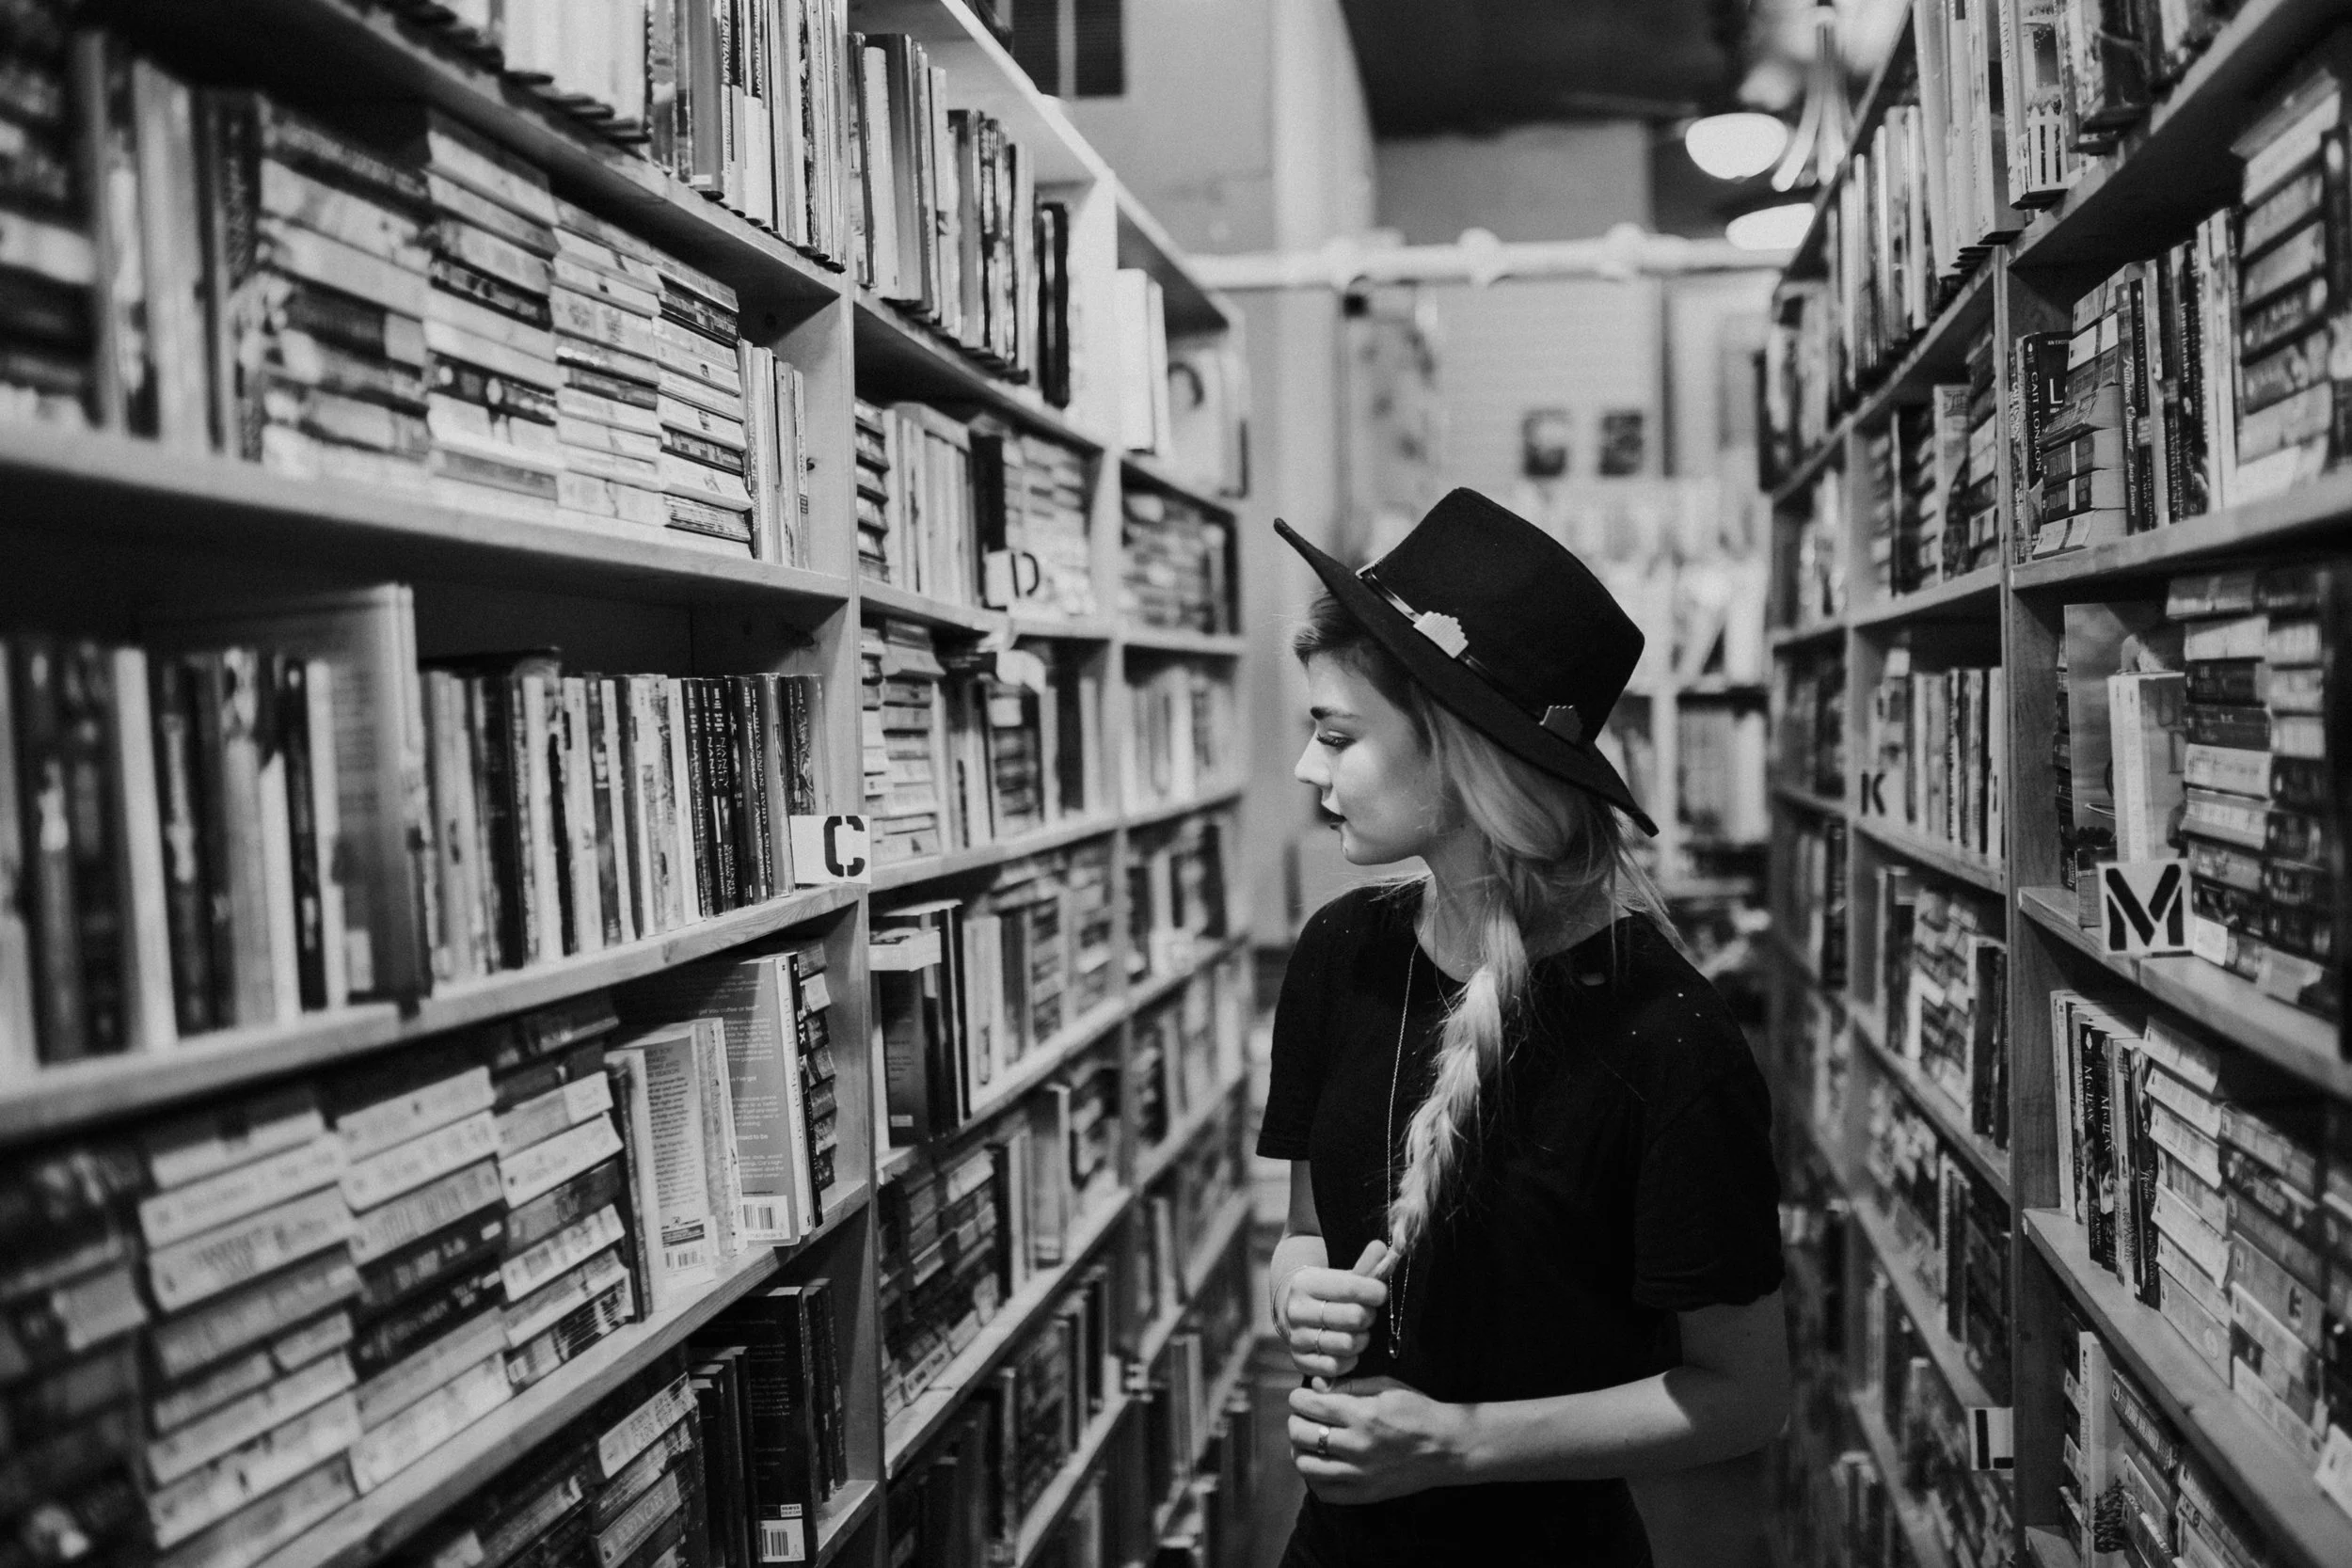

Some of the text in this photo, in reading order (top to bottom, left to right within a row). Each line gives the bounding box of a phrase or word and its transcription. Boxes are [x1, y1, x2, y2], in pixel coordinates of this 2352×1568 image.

[2031, 371, 2042, 472] CAIT LONDON
[1010, 551, 1040, 598] D
[720, 736, 730, 789] NANCY
[1861, 769, 1886, 817] K
[823, 815, 866, 878] C
[2106, 863, 2185, 951] M
[1975, 1408, 2014, 1470] L
